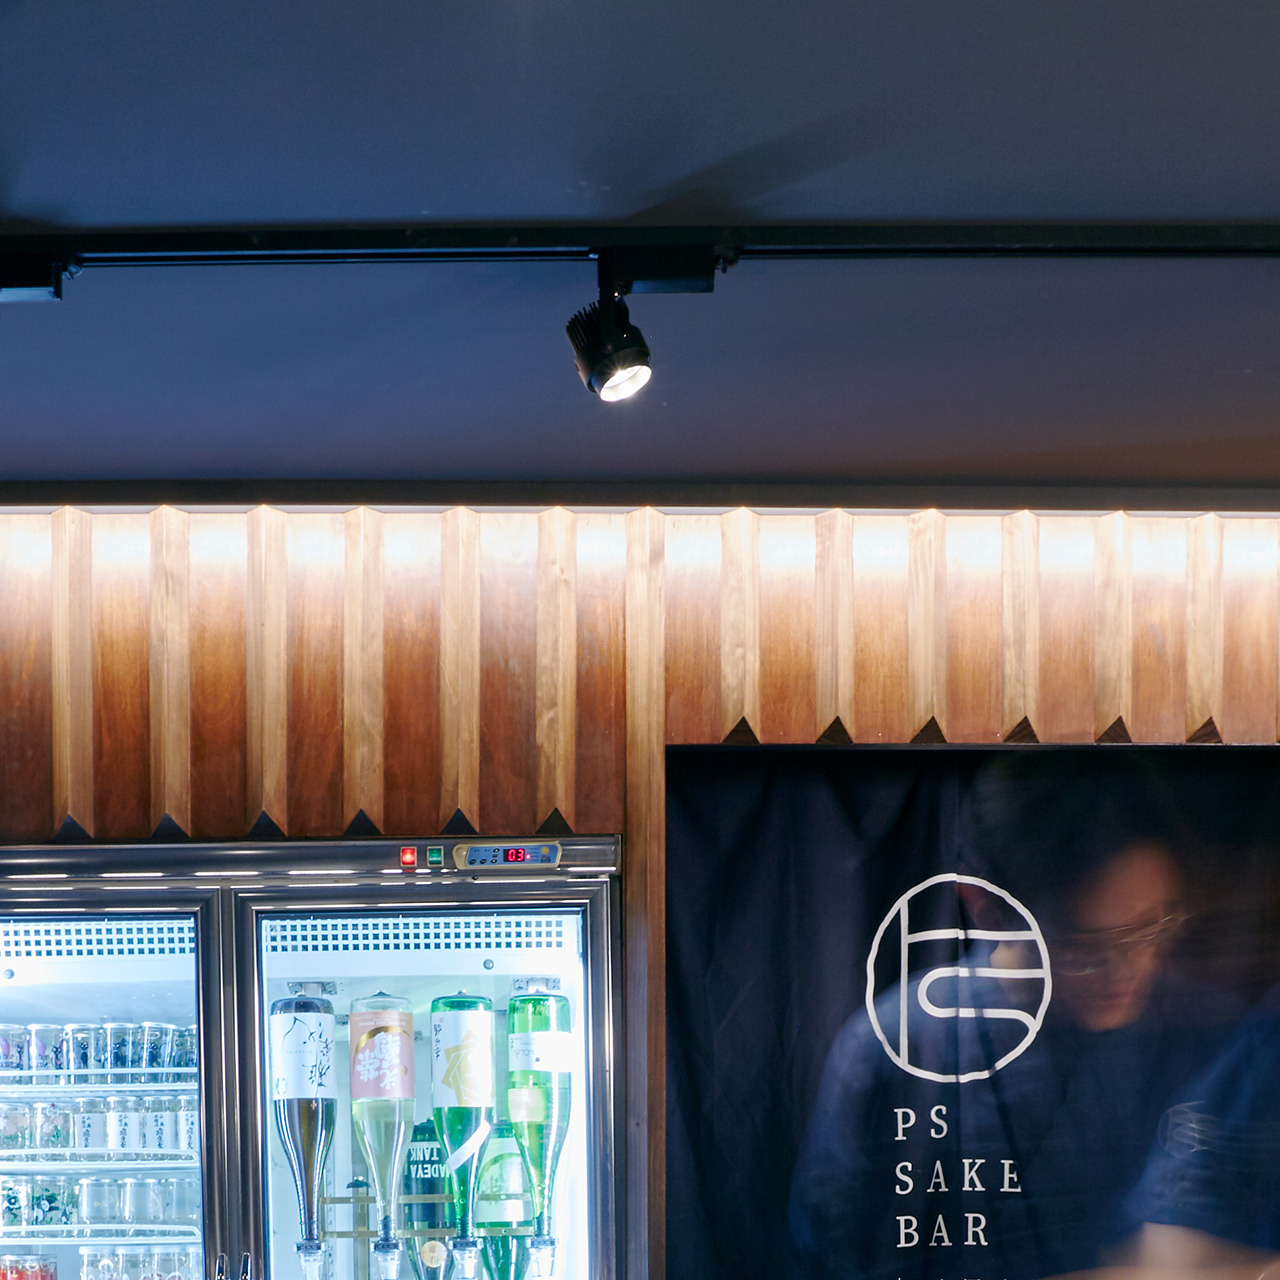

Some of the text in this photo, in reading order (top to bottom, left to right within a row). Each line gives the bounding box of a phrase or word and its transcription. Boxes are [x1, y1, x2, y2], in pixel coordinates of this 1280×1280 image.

[507, 848, 525, 862] 03
[893, 1104, 949, 1141] PS
[409, 1147, 439, 1161] TANK
[895, 1158, 1023, 1196] SAKE
[896, 1212, 989, 1249] BAR
